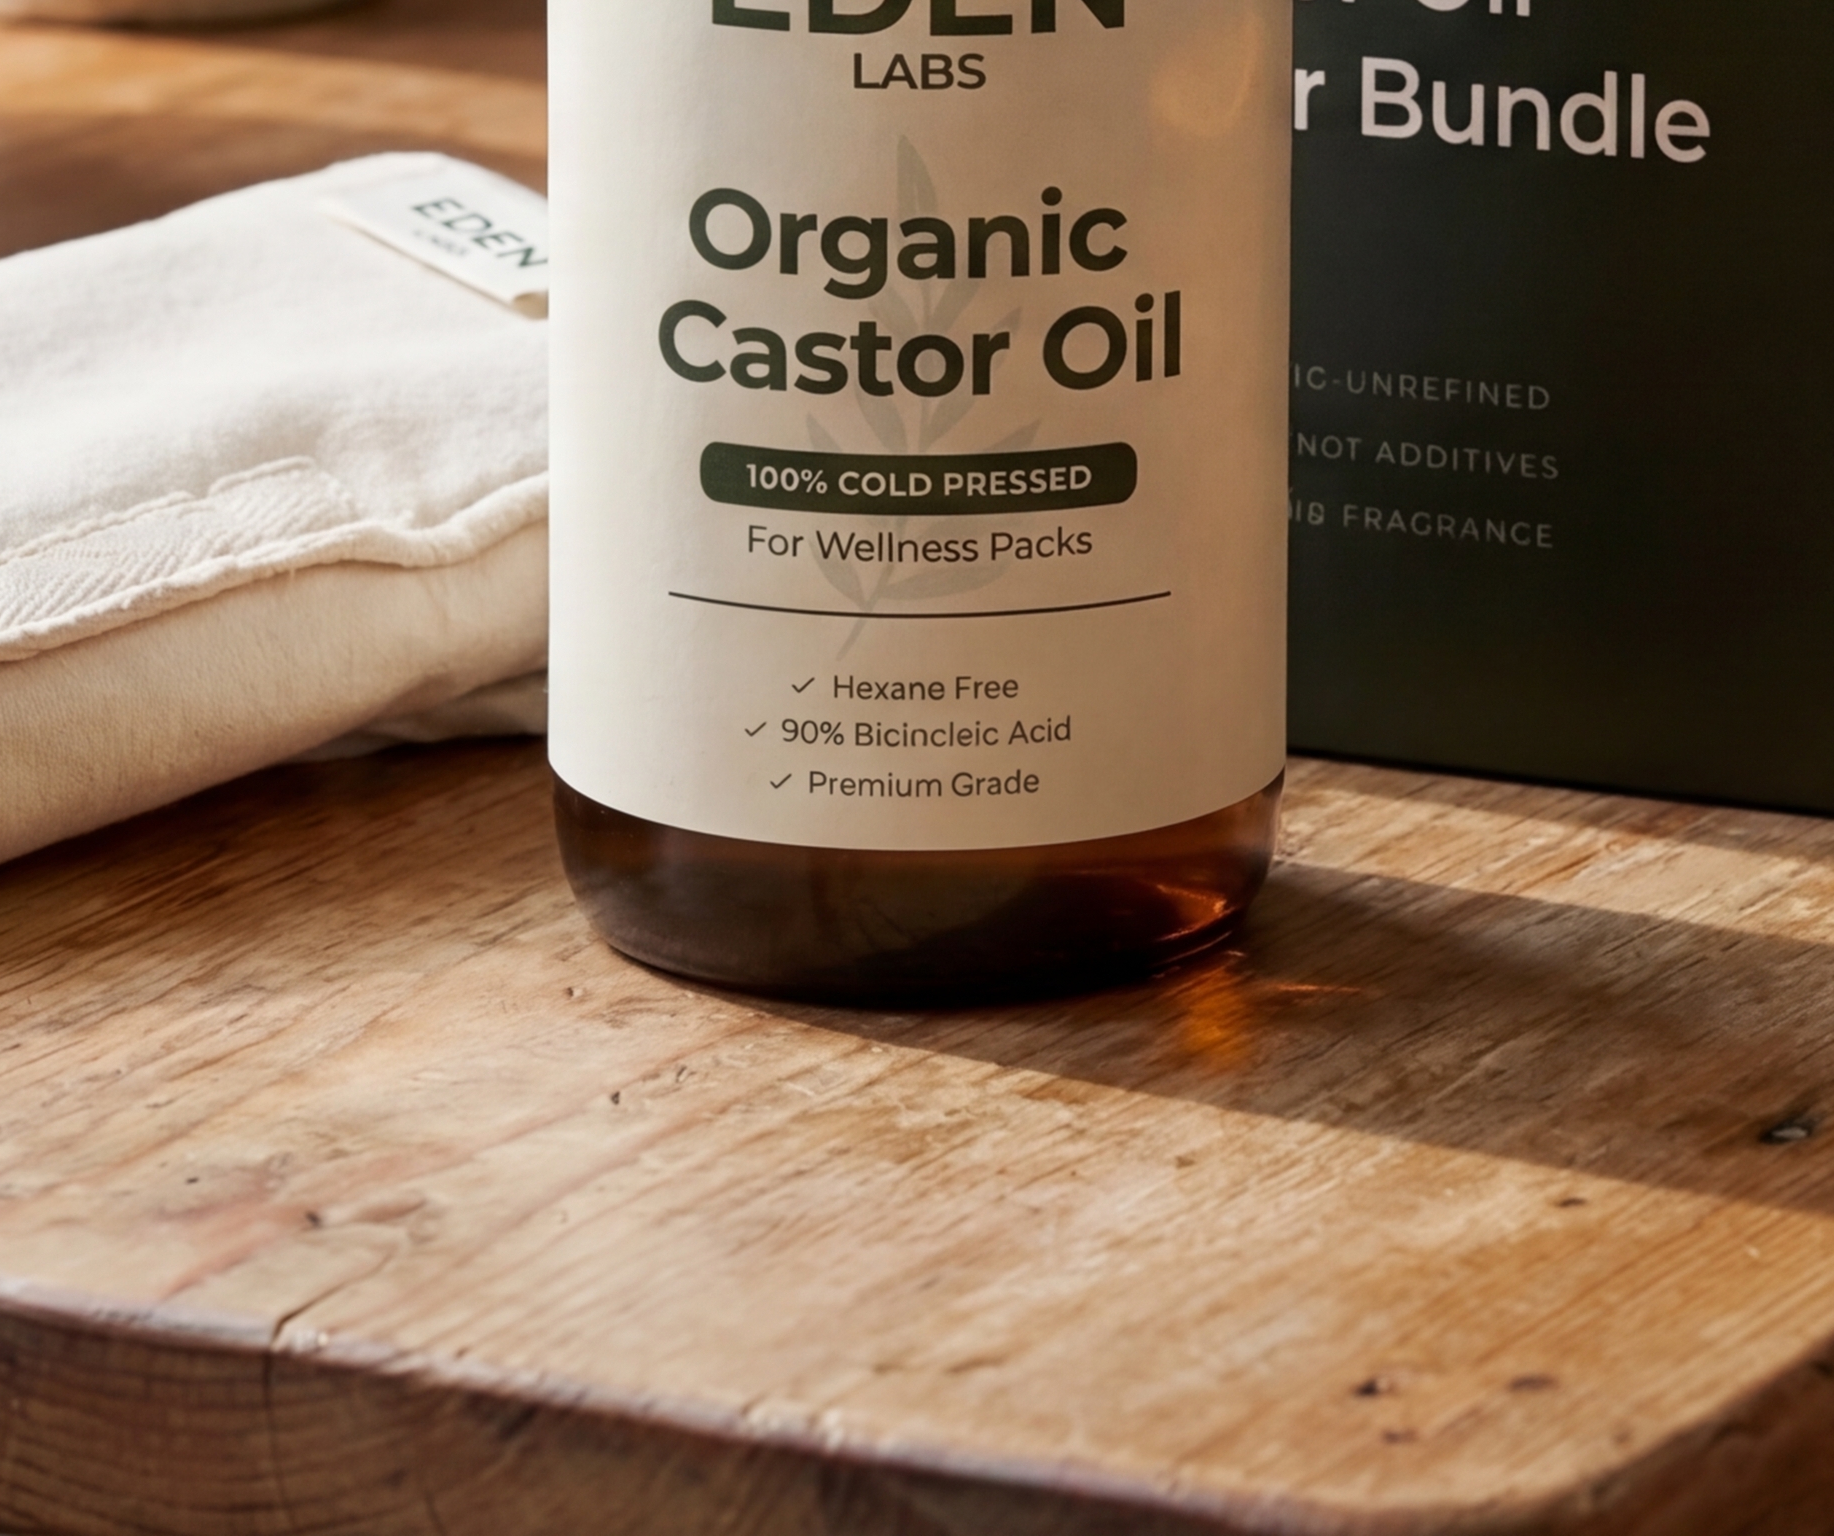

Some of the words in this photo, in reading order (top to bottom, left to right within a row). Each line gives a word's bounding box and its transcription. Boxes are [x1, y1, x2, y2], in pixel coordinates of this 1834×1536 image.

[854, 53, 986, 90] LABS
[1362, 57, 1709, 162] Bundle
[411, 196, 547, 268] EDEN
[688, 186, 1128, 300] Organic
[658, 299, 1010, 398] Castor
[1043, 291, 1180, 390] Oil
[1376, 441, 1558, 478] ADDITIVES
[747, 464, 827, 493] 100%
[839, 471, 931, 496] COLD
[943, 464, 1092, 496] PRESSED
[749, 525, 804, 557] For
[817, 531, 979, 562] Wellness
[991, 527, 1092, 560] Packs
[834, 676, 945, 701] Hexane
[956, 676, 1018, 699] Free
[782, 719, 844, 745] 90%
[855, 721, 999, 747] Bicincleic
[1008, 715, 1071, 744] Acid
[810, 771, 942, 798] Premium
[951, 769, 1040, 797] Grade
